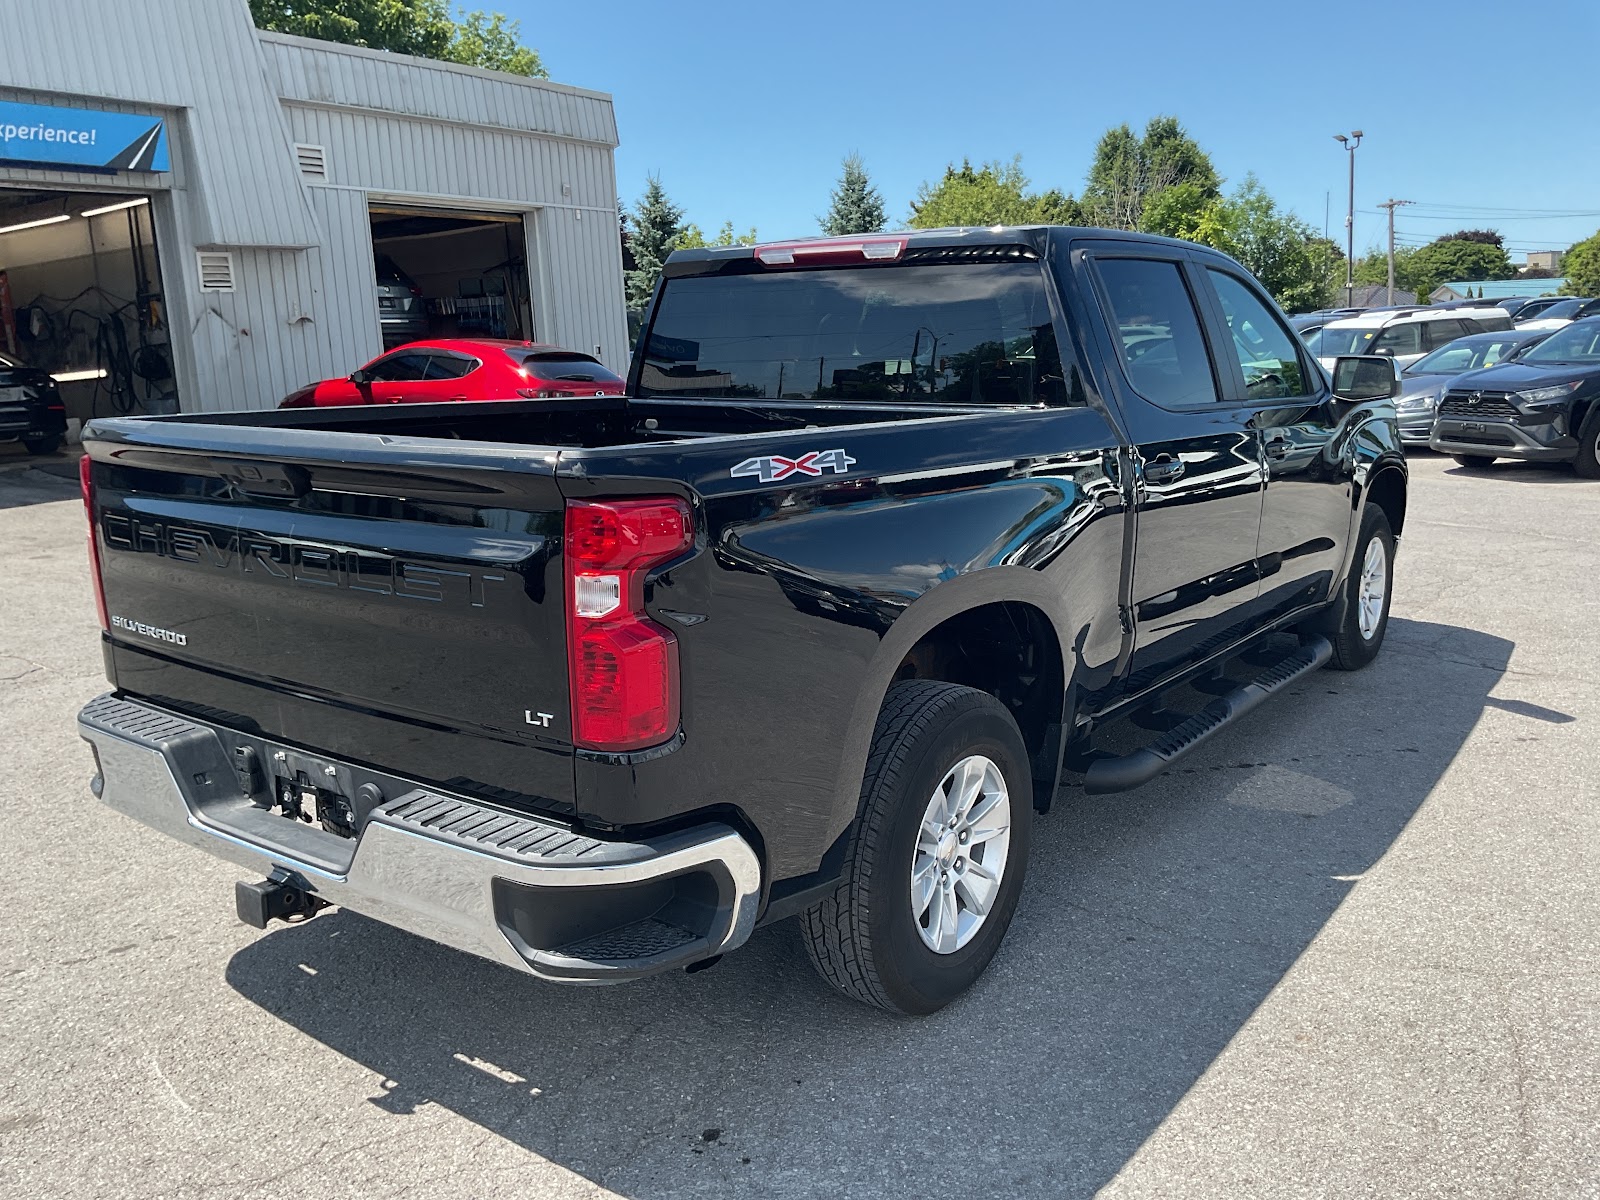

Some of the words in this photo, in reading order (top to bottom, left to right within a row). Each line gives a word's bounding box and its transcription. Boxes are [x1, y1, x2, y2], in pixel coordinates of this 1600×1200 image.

[103, 513, 506, 608] CHEVROLET
[112, 615, 187, 646] SILVERADO
[524, 709, 554, 728] LT
